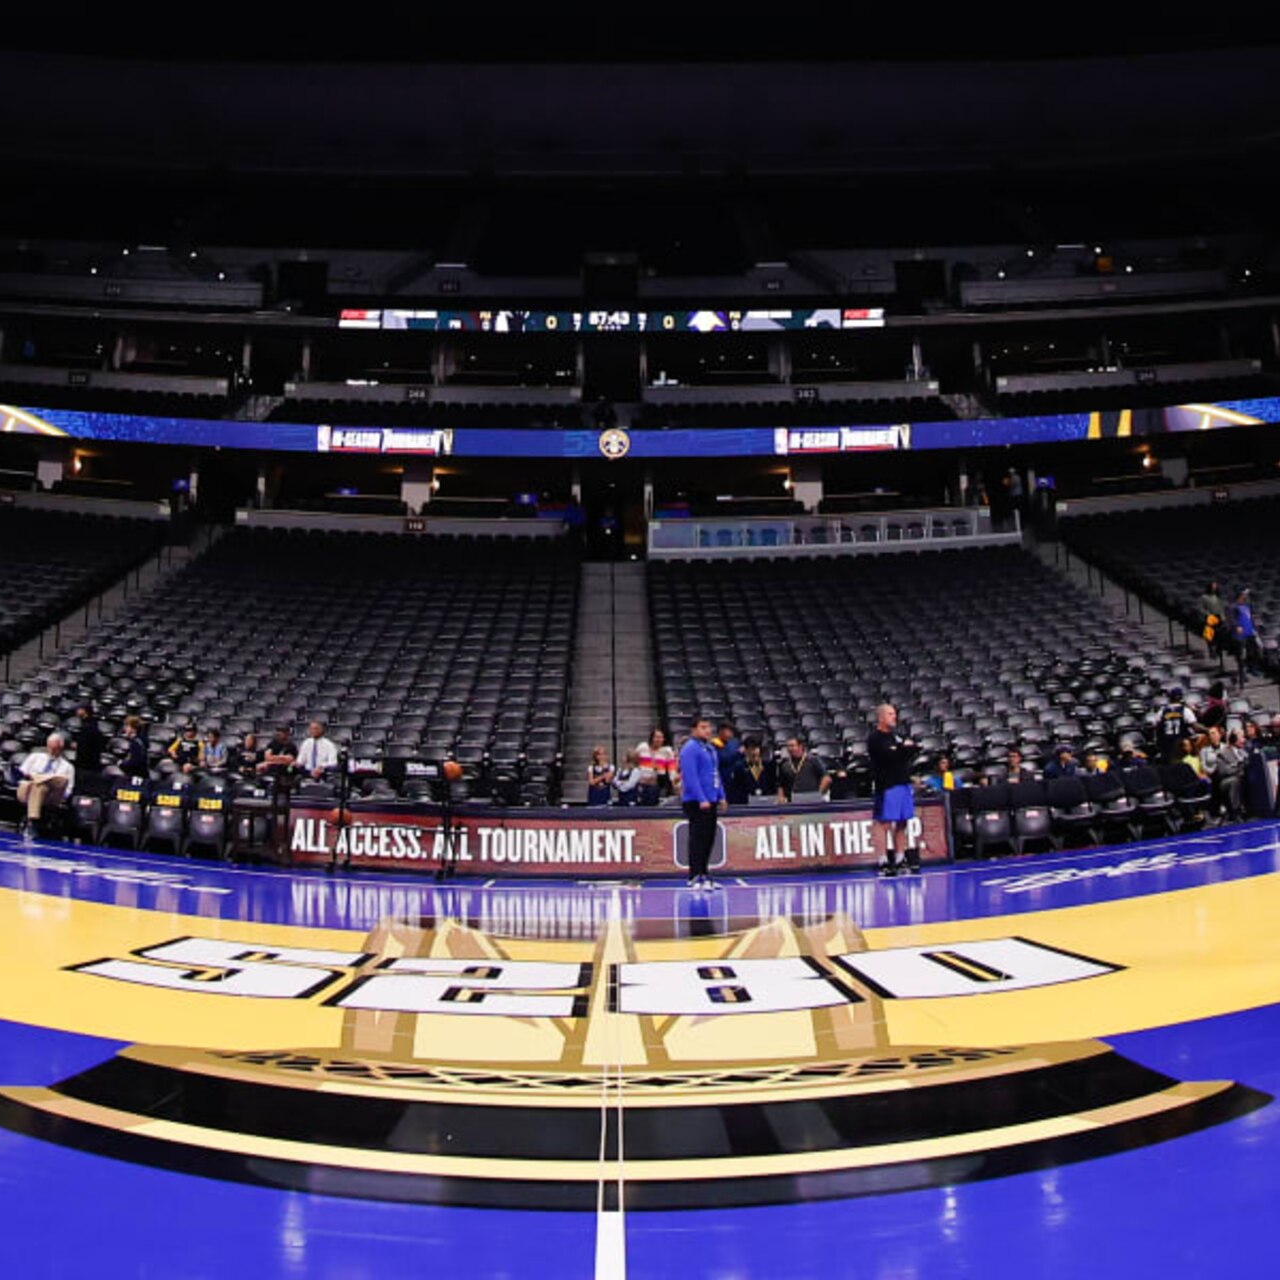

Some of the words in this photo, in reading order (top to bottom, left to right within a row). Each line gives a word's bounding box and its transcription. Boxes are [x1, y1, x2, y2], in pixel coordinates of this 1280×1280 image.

[547, 315, 558, 330] 0
[291, 818, 329, 853] ALL
[336, 823, 427, 858] ACCESS.
[478, 827, 641, 863] TOURNAMENT.
[754, 824, 796, 860] ALL
[800, 822, 825, 857] IN
[830, 820, 875, 855] THE
[59, 936, 1128, 1018] 5280
